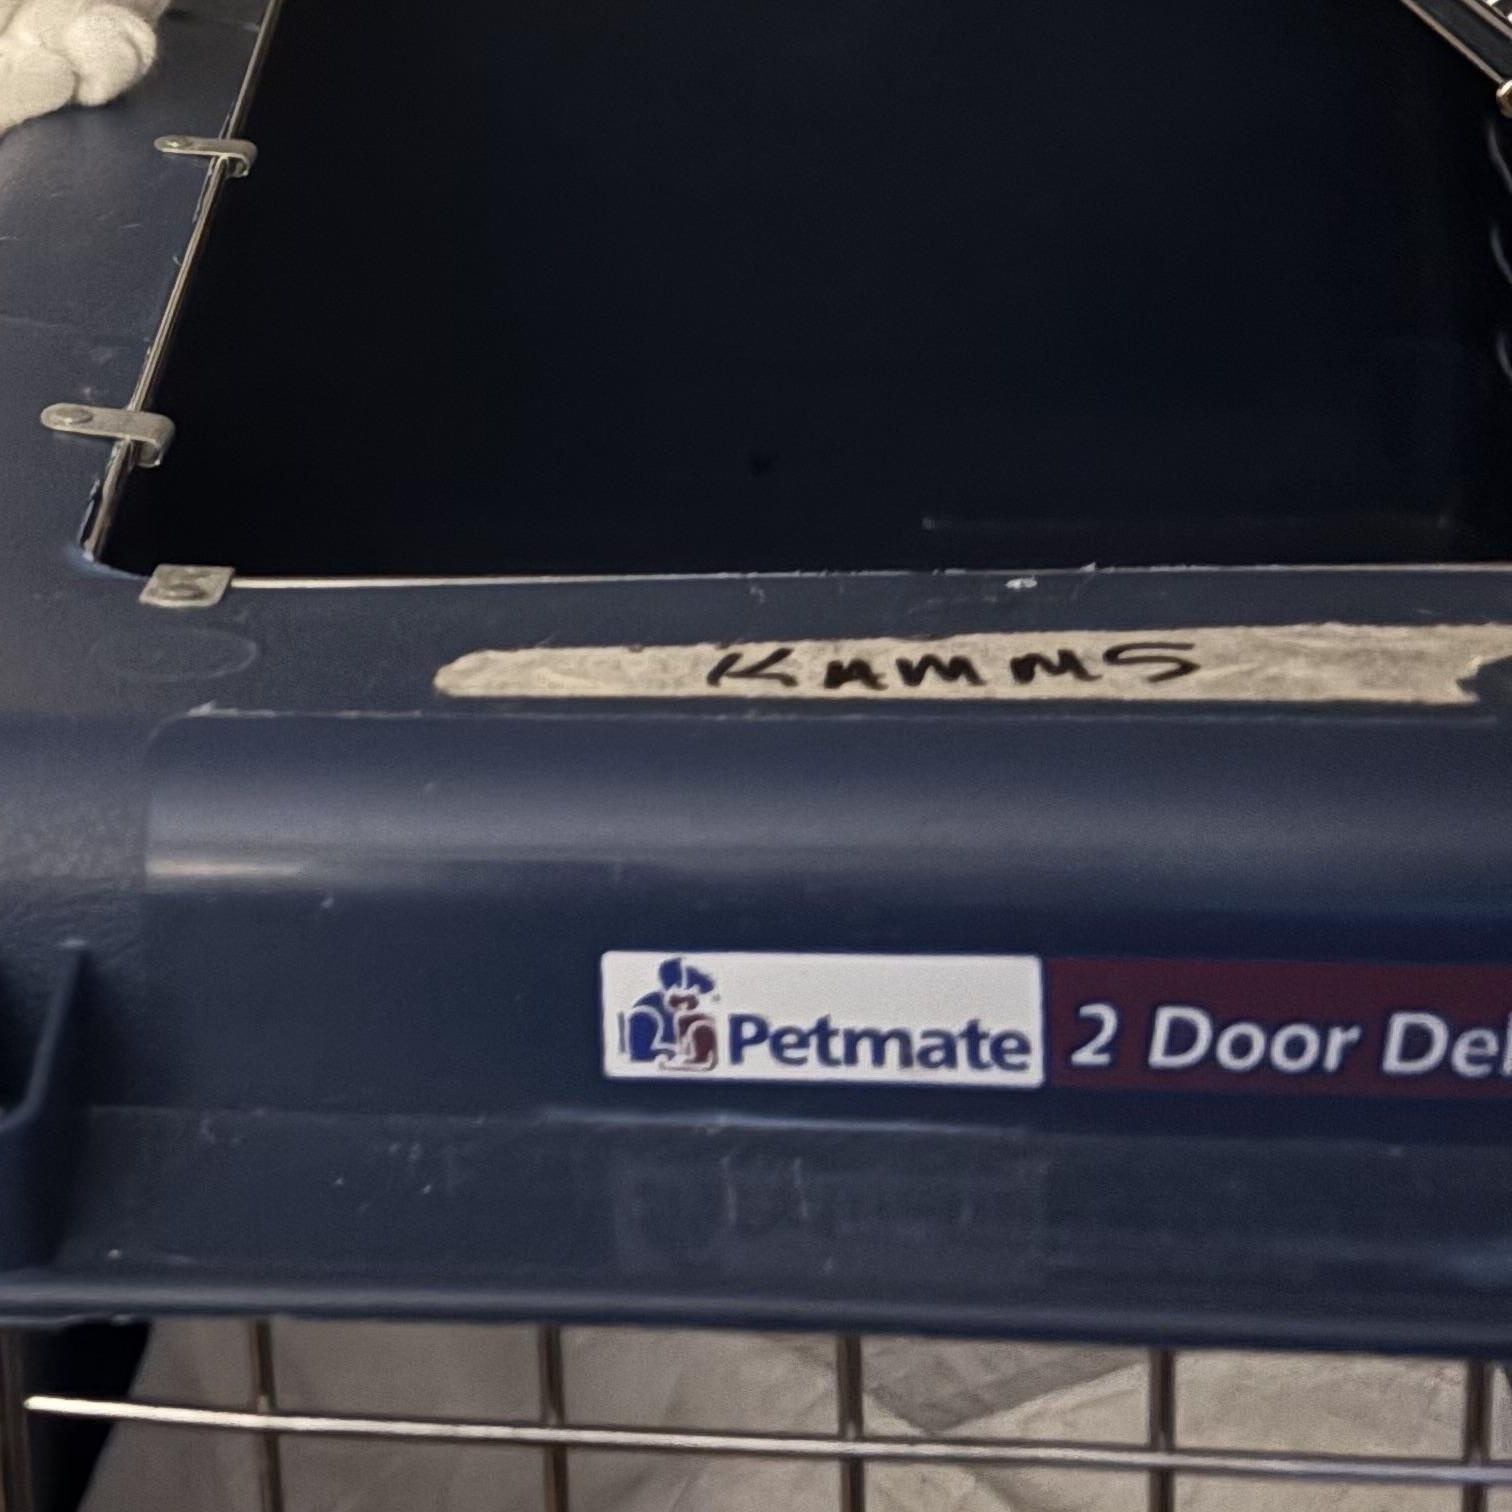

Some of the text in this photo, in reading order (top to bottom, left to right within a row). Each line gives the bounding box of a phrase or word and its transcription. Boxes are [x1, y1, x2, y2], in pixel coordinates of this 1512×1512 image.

[727, 1013, 1032, 1072] Petmate
[1070, 1002, 1119, 1067] 2
[1147, 1005, 1363, 1073] Door
